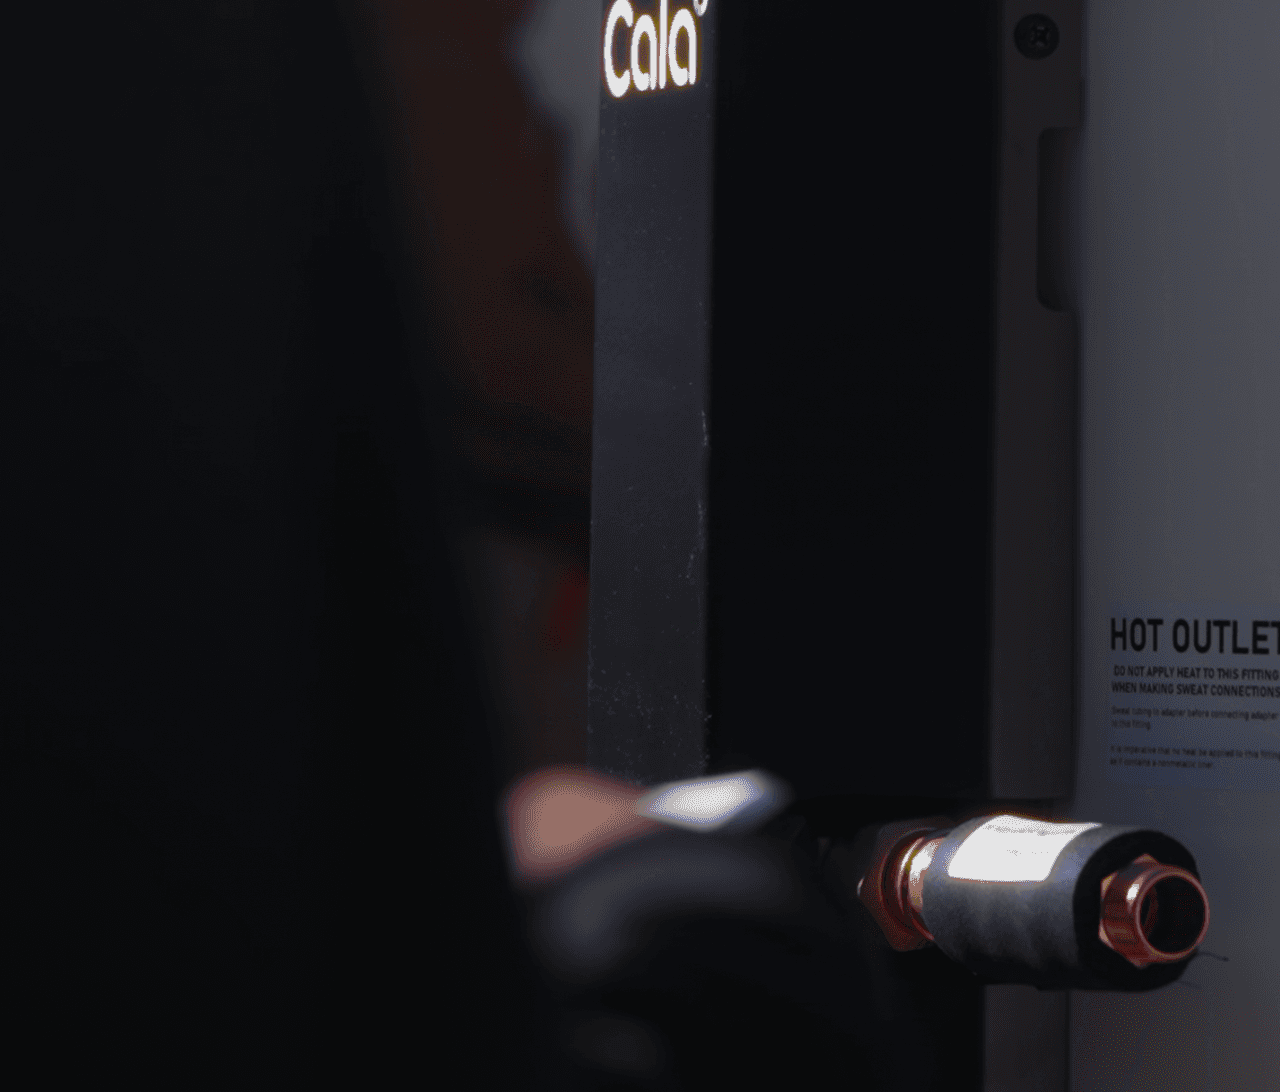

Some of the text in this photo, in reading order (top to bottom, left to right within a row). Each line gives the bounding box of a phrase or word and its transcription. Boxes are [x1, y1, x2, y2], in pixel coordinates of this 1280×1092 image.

[1110, 617, 1163, 651] HOT
[1113, 664, 1279, 680] DO NOT APPLY HEAT TO THIS FITTING
[1111, 681, 1136, 693] WHEN
[1139, 682, 1174, 694] MAKING
[1176, 683, 1208, 695] SWEAT
